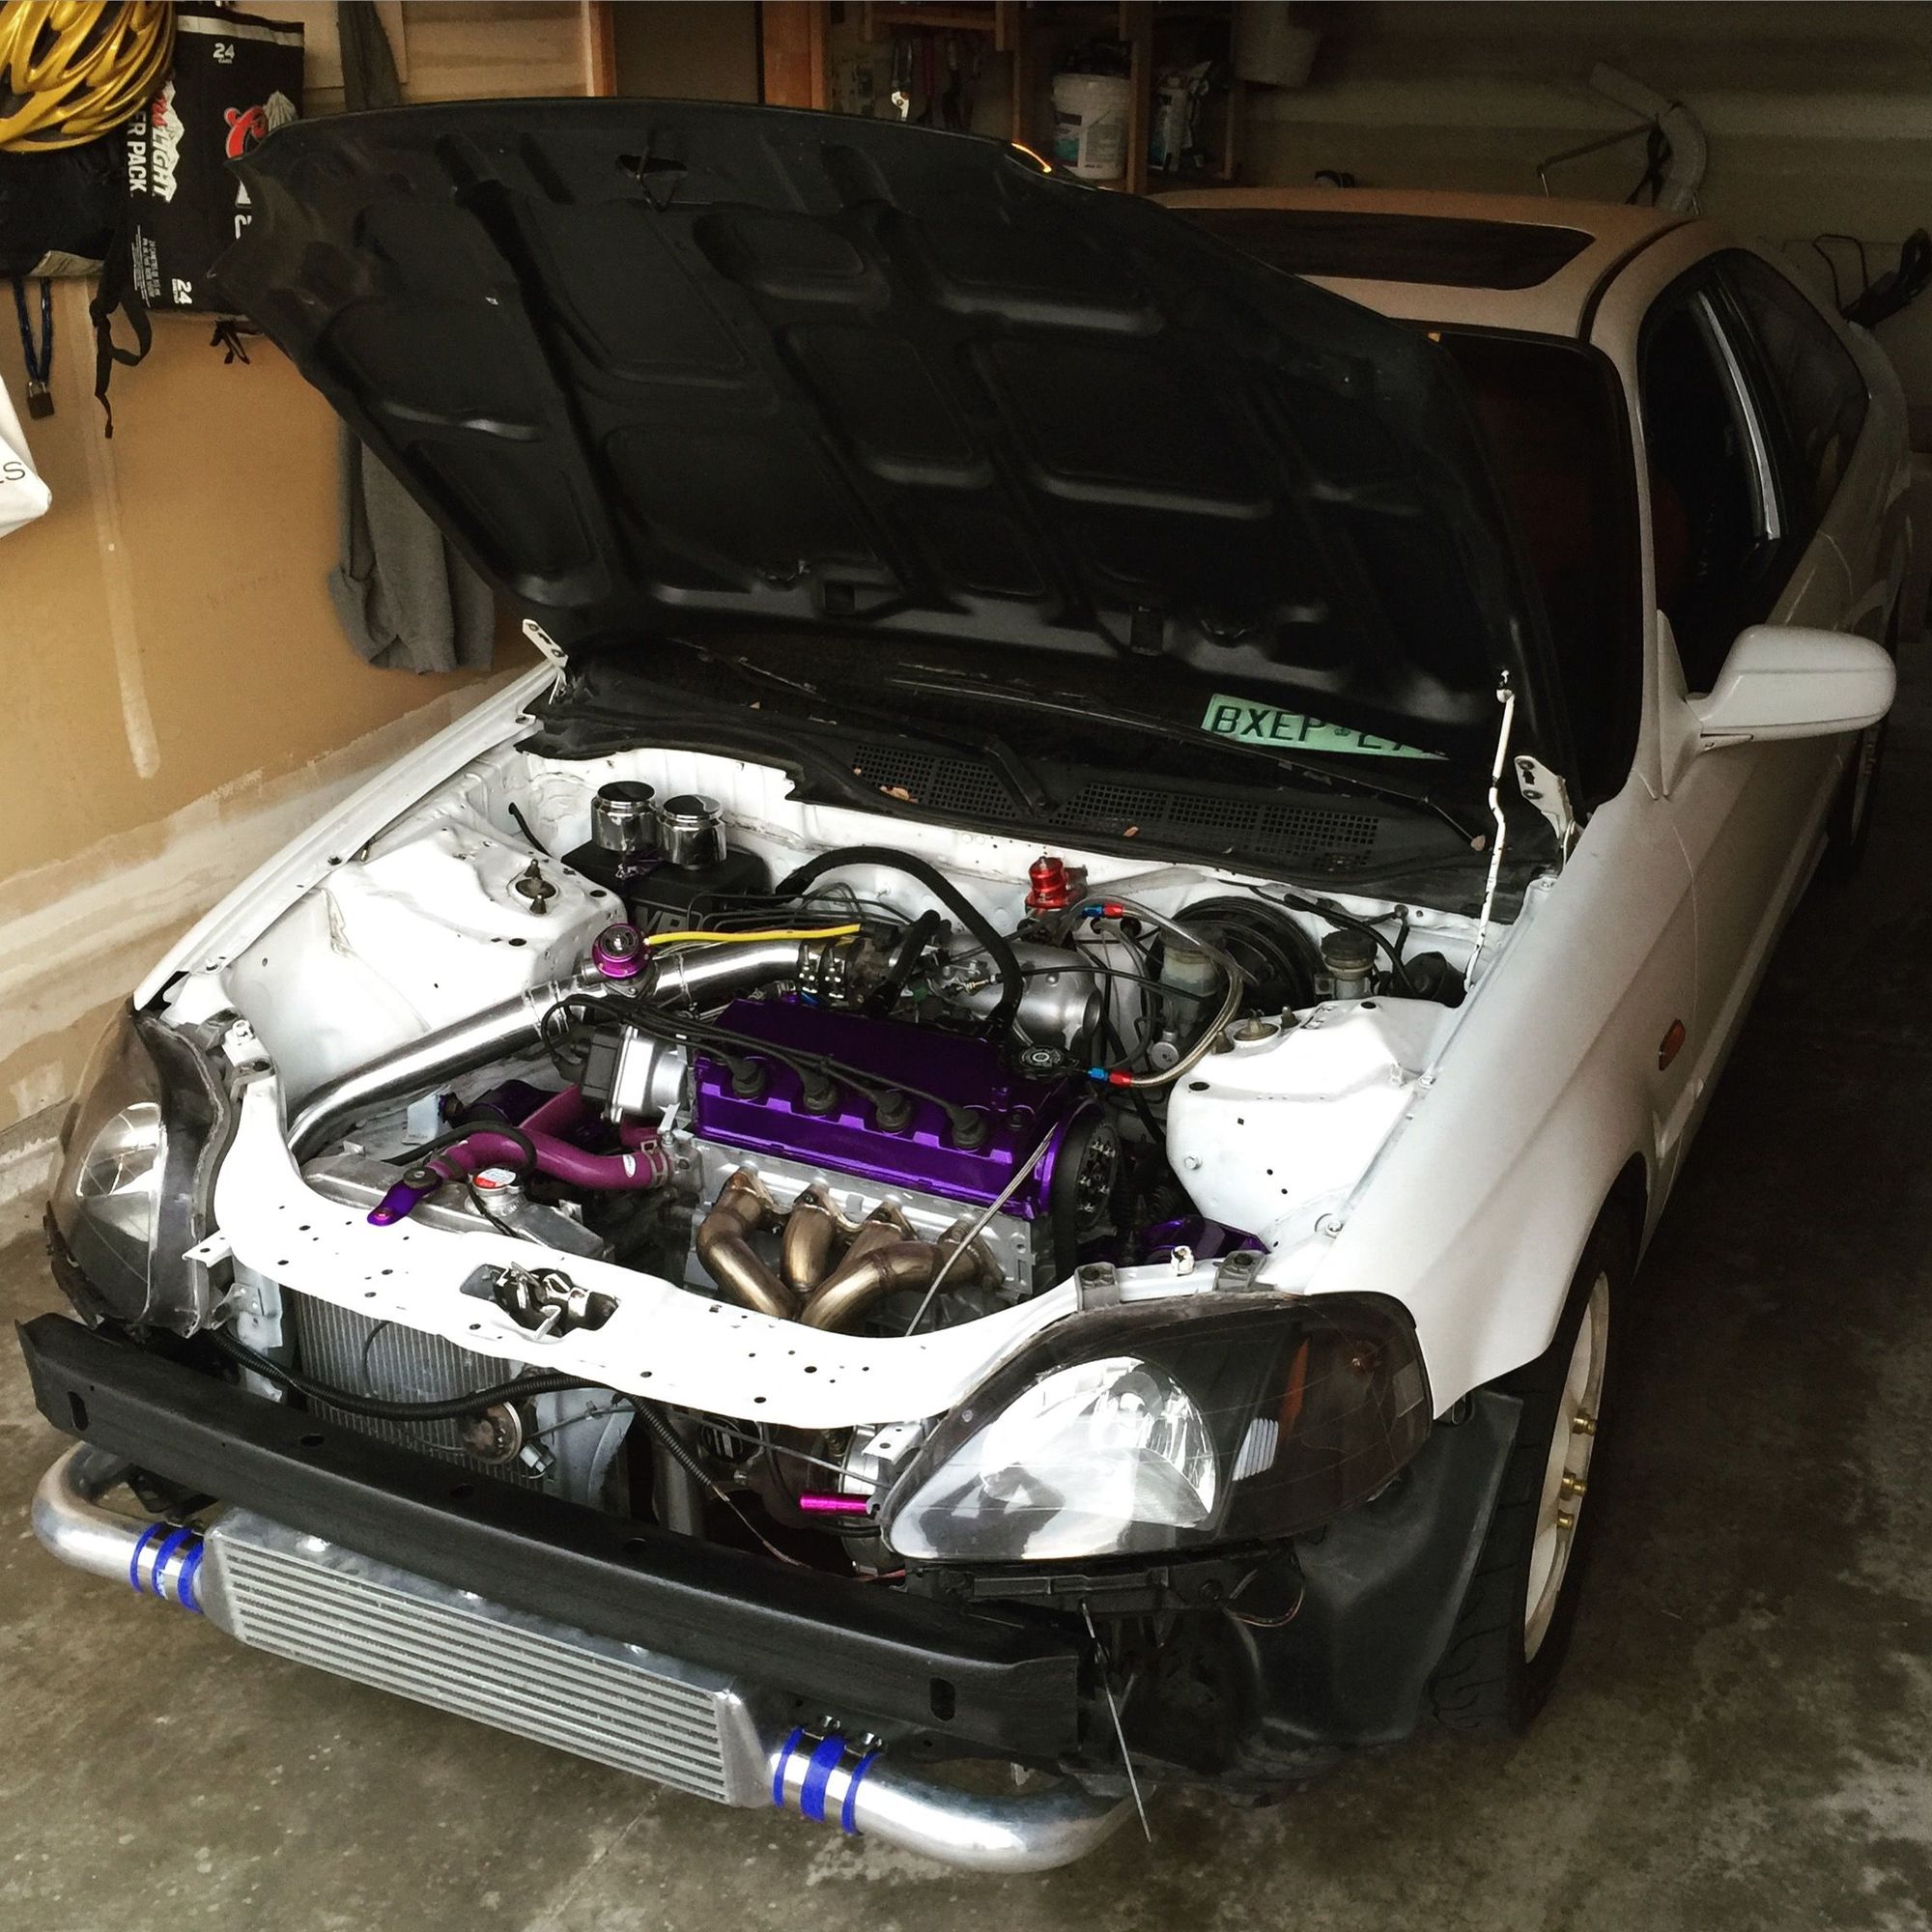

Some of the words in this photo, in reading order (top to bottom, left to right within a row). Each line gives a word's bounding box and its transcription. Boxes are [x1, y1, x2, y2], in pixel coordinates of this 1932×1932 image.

[213, 42, 236, 59] 24
[127, 140, 148, 193] PACK
[152, 126, 175, 202] LIGHT
[177, 278, 193, 305] 24
